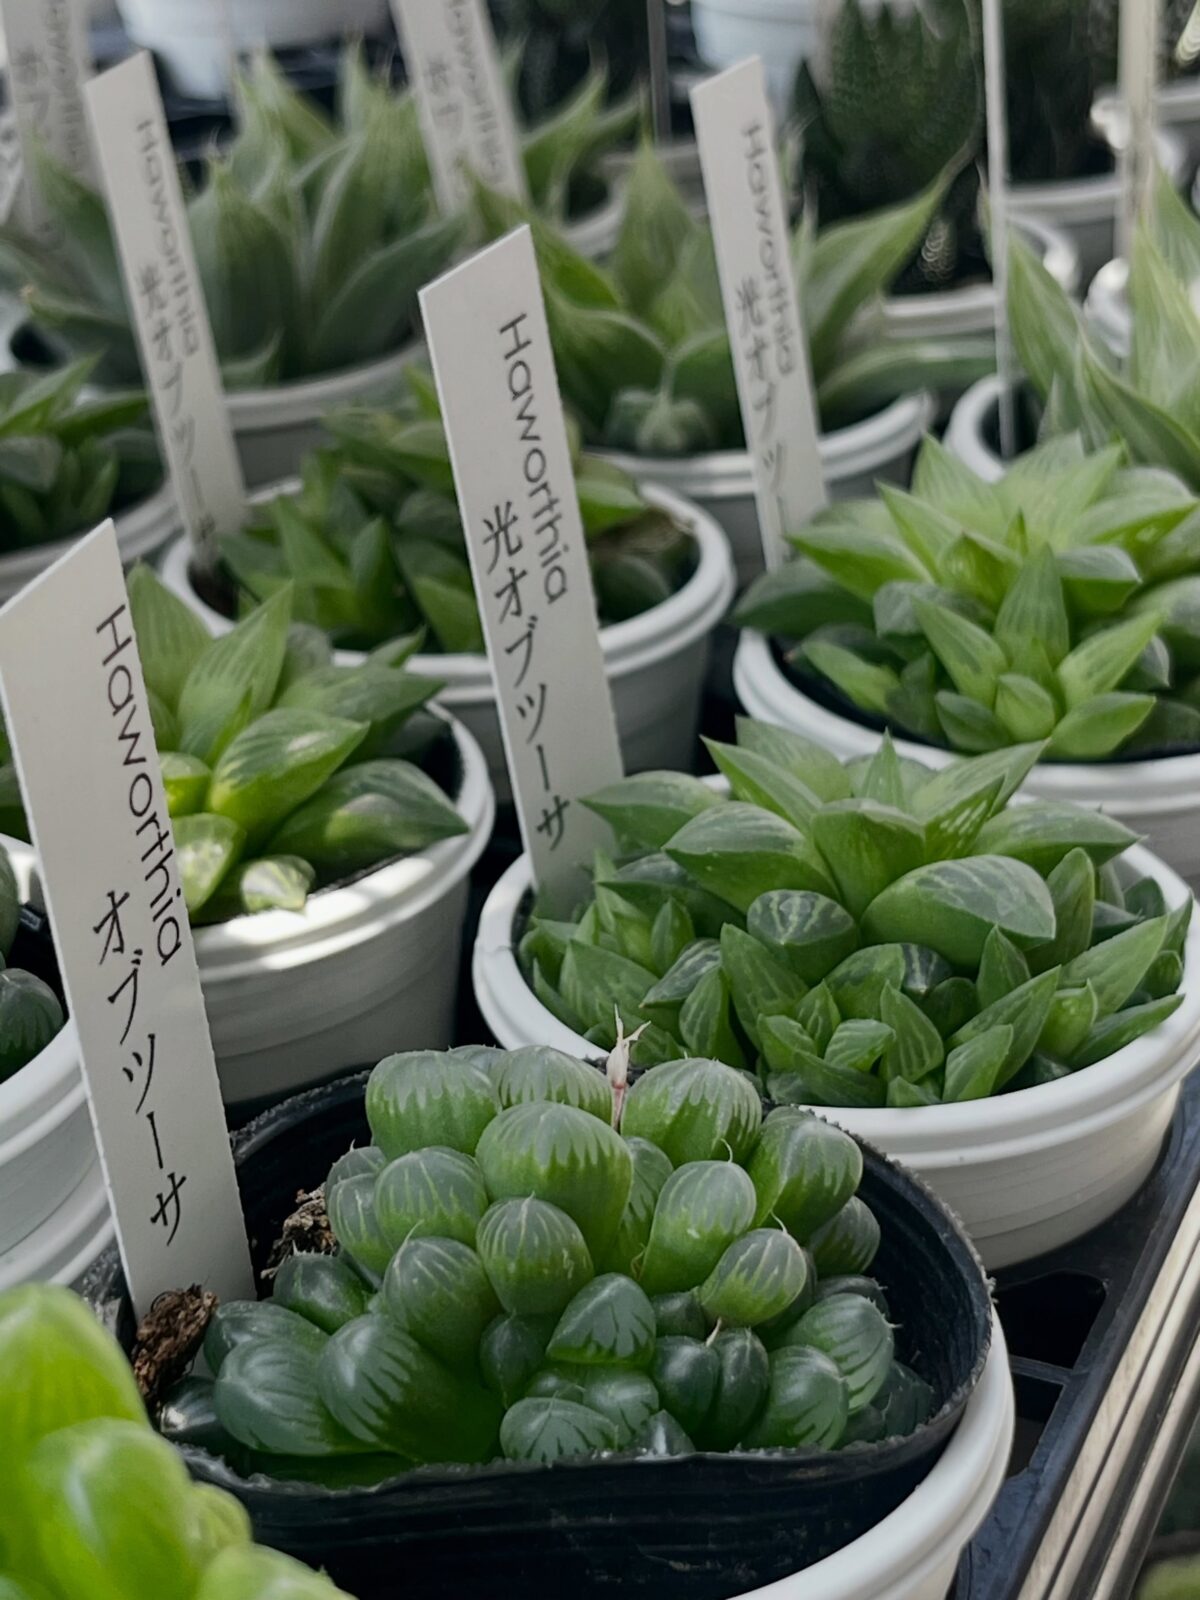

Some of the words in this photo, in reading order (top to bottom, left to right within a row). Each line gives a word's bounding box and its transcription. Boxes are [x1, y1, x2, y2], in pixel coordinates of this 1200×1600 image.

[499, 313, 568, 604] Haworthia
[95, 603, 183, 967] Haworthia
[482, 501, 570, 851] 光オブツーサ
[93, 889, 187, 1247] オブツーサ
